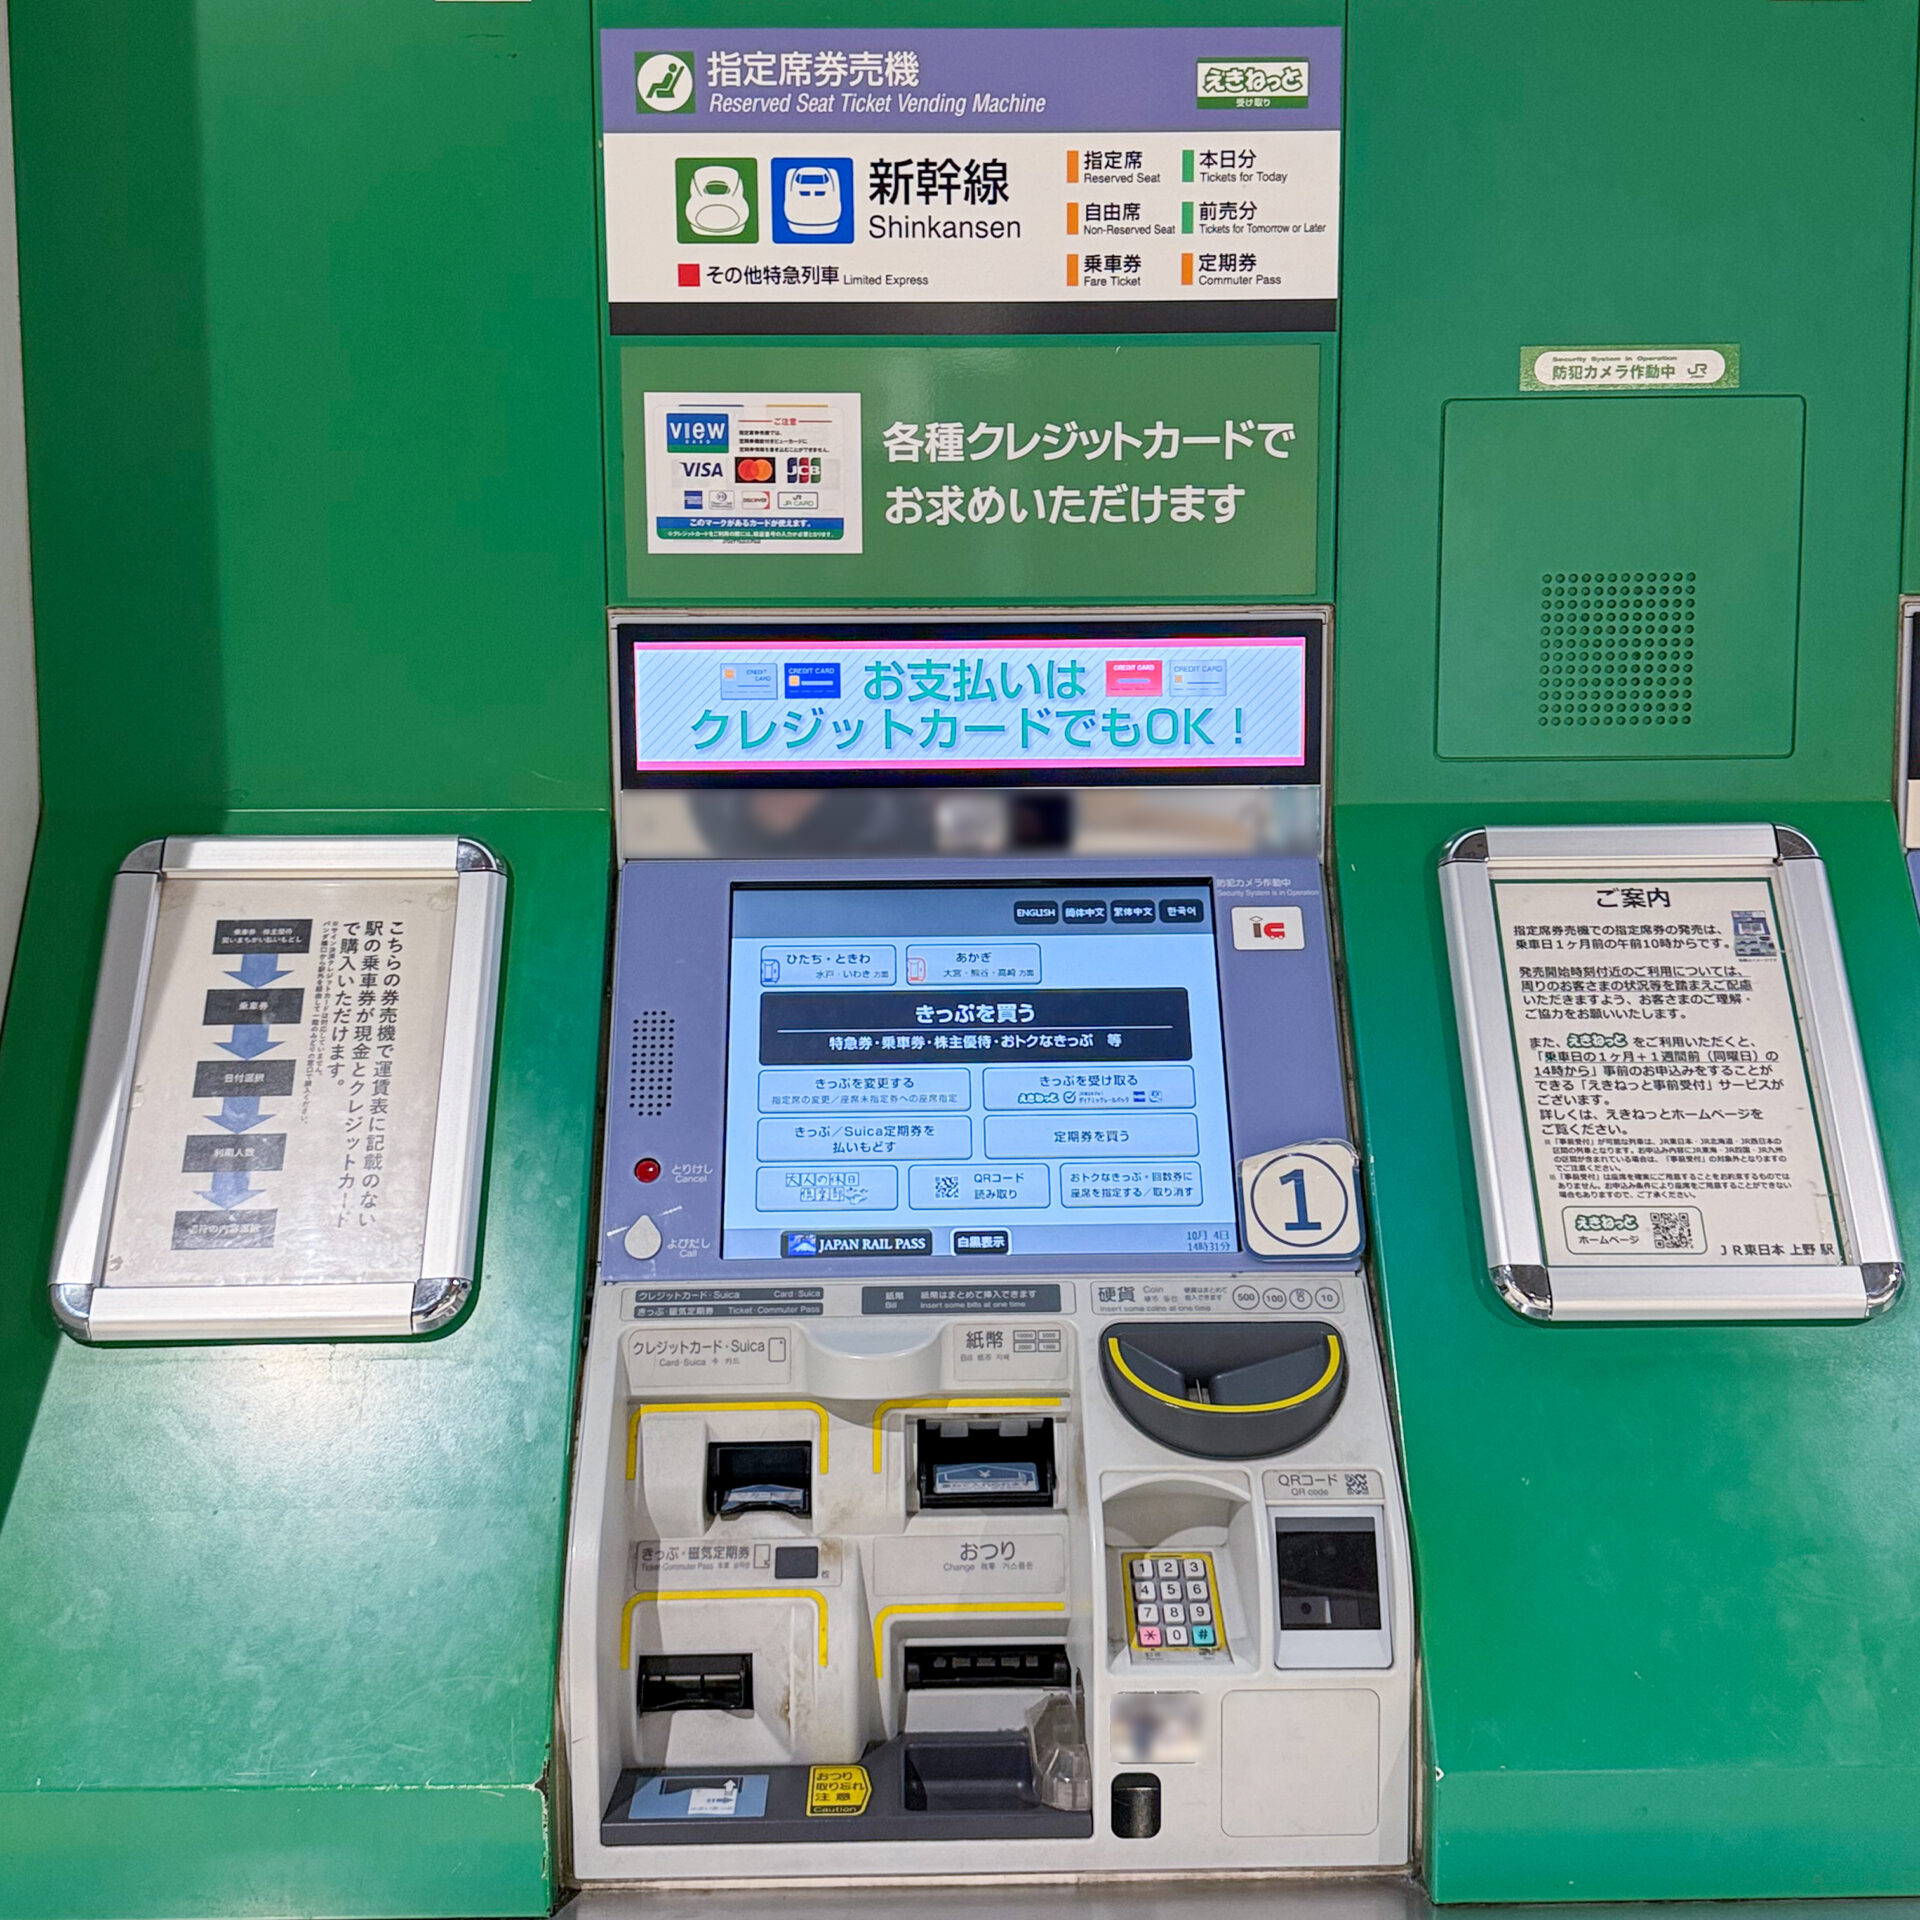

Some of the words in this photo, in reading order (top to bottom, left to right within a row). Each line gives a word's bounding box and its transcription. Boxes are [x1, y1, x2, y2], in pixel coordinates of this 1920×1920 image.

[706, 50, 920, 88] 指定席券売機
[1203, 66, 1304, 94] えきねっと
[709, 94, 790, 114] Reserved
[796, 94, 838, 114] Seat
[841, 94, 892, 114] Ticket
[896, 93, 967, 116] Vending
[972, 93, 1047, 114] Machine
[1236, 98, 1271, 108] 受け取り
[1084, 150, 1144, 170] 指定席
[1200, 150, 1257, 169] 本日分
[868, 158, 1010, 206] 新幹線
[1084, 173, 1134, 184] Reserved
[1136, 173, 1160, 184] Seat
[1200, 172, 1236, 182] Tickets
[1239, 172, 1254, 182] for
[1257, 172, 1288, 184] Today
[1084, 202, 1142, 222] 自由席
[1199, 202, 1258, 220] 前売分
[868, 216, 1021, 240] Shinkansen
[1084, 224, 1151, 235] Non-Reserved
[1154, 224, 1176, 235] Seat
[1200, 224, 1230, 234] Tickets
[1232, 223, 1245, 234] for
[1247, 223, 1290, 234] Tomorrow
[1292, 224, 1302, 234] or
[1303, 222, 1326, 233] Later
[1084, 254, 1142, 273] 乗車券
[1198, 253, 1257, 272] 定期券
[706, 265, 840, 285] その他特急列車
[843, 274, 882, 286] Limited
[885, 274, 929, 288] Express
[1084, 276, 1107, 286] Fare
[1111, 276, 1140, 286] Ticket
[1199, 274, 1253, 286] Commuter
[1256, 274, 1282, 285] Pass
[1552, 364, 1676, 380] 防犯カメラ作動中
[1687, 363, 1708, 376] JR
[774, 417, 797, 426] ご注意
[883, 420, 1296, 462] 各種クレジットカードで
[680, 462, 724, 477] VISA
[884, 482, 1246, 526] お求めいただけます
[864, 658, 1086, 702] お支払いは
[1216, 878, 1292, 888] 防犯カメラ作動中
[1596, 888, 1671, 908] ご案内
[1016, 908, 1056, 918] ENGLISH
[1166, 906, 1197, 916] 한국어
[1514, 924, 1722, 936] 指定席券売機での指定席券の発売は、
[786, 954, 871, 964] ひたち・ときわ
[956, 952, 992, 963] あかぎ
[1519, 966, 1743, 978] 発売開始時刻付近のご利用については、
[1522, 980, 1752, 992] 周りのお客さまの状況等を踏まえご配慮
[328, 922, 362, 1087] で購入いただけます。
[915, 1003, 1036, 1024] きっぷを買う
[1525, 1008, 1687, 1020] ご協力をお願いいたします。
[828, 1034, 1094, 1050] 特急券・乗車券・株主優待・おトクなきっぷ
[1107, 1034, 1122, 1048] 等
[336, 920, 384, 1228] 駅の乗車券が現金とクレジットカード
[358, 920, 404, 1228] こちらの券売機で運賃表に記載のない
[1040, 1074, 1138, 1086] きっぷを受け取る
[815, 1078, 915, 1090] きっぷを変更する
[1535, 1079, 1784, 1092] できる「えきねっと事前受付」サービスが
[1537, 1094, 1610, 1106] ございます。
[1540, 1108, 1763, 1120] 詳しくは、えきねっとホームページを
[794, 1126, 935, 1138] きっぷ／Suica定期券を
[1542, 1124, 1628, 1136] ご覧ください。
[1054, 1130, 1130, 1143] 定期券を買う
[832, 1141, 896, 1154] 払いもどす
[672, 1164, 714, 1175] とりけし
[675, 1175, 708, 1183] Cancel
[974, 1173, 1024, 1184] QRコード
[1070, 1172, 1193, 1183] おトクなきっぷ・回数券に
[974, 1188, 1018, 1200] 読み取り
[1070, 1187, 1194, 1198] 座席を指定する／取り消す
[1279, 1169, 1322, 1231] 1
[1575, 1214, 1640, 1231] えきねっと
[957, 1235, 1006, 1249] 白黒表示
[1187, 1231, 1208, 1241] 10月
[1578, 1235, 1640, 1245] ホームページ
[666, 1238, 710, 1250] よびだし
[819, 1239, 860, 1252] JAPAN
[862, 1238, 893, 1250] RAIL
[897, 1237, 926, 1250] PASS
[679, 1250, 698, 1258] Call
[638, 1290, 740, 1300] クレジットカード・Suica
[1098, 1286, 1136, 1302] 硬貨
[1142, 1286, 1164, 1294] Coin
[1237, 1293, 1255, 1302] 500
[1266, 1294, 1284, 1302] 100
[1322, 1294, 1334, 1302] 10
[800, 1306, 820, 1314] Pass
[966, 1331, 1004, 1349] 紙幣
[634, 1340, 765, 1356] クレジットカード・Suica
[1278, 1474, 1338, 1487] QRコード
[1291, 1488, 1306, 1496] QR
[1307, 1488, 1328, 1496] code
[960, 1540, 1016, 1560] おつり
[943, 1562, 976, 1572] Change
[1139, 1563, 1145, 1573] 1
[1164, 1562, 1173, 1572] 2
[1190, 1562, 1198, 1572] 3
[1140, 1585, 1149, 1594] 4
[1167, 1584, 1176, 1594] 5
[1193, 1584, 1202, 1594] 6
[1144, 1607, 1152, 1618] 7
[1170, 1607, 1179, 1618] 8
[1196, 1606, 1204, 1616] 9
[1172, 1630, 1182, 1640] 0
[816, 1772, 853, 1780] おつり
[816, 1782, 864, 1791] 取り忘れ
[812, 1806, 856, 1814] Caution
